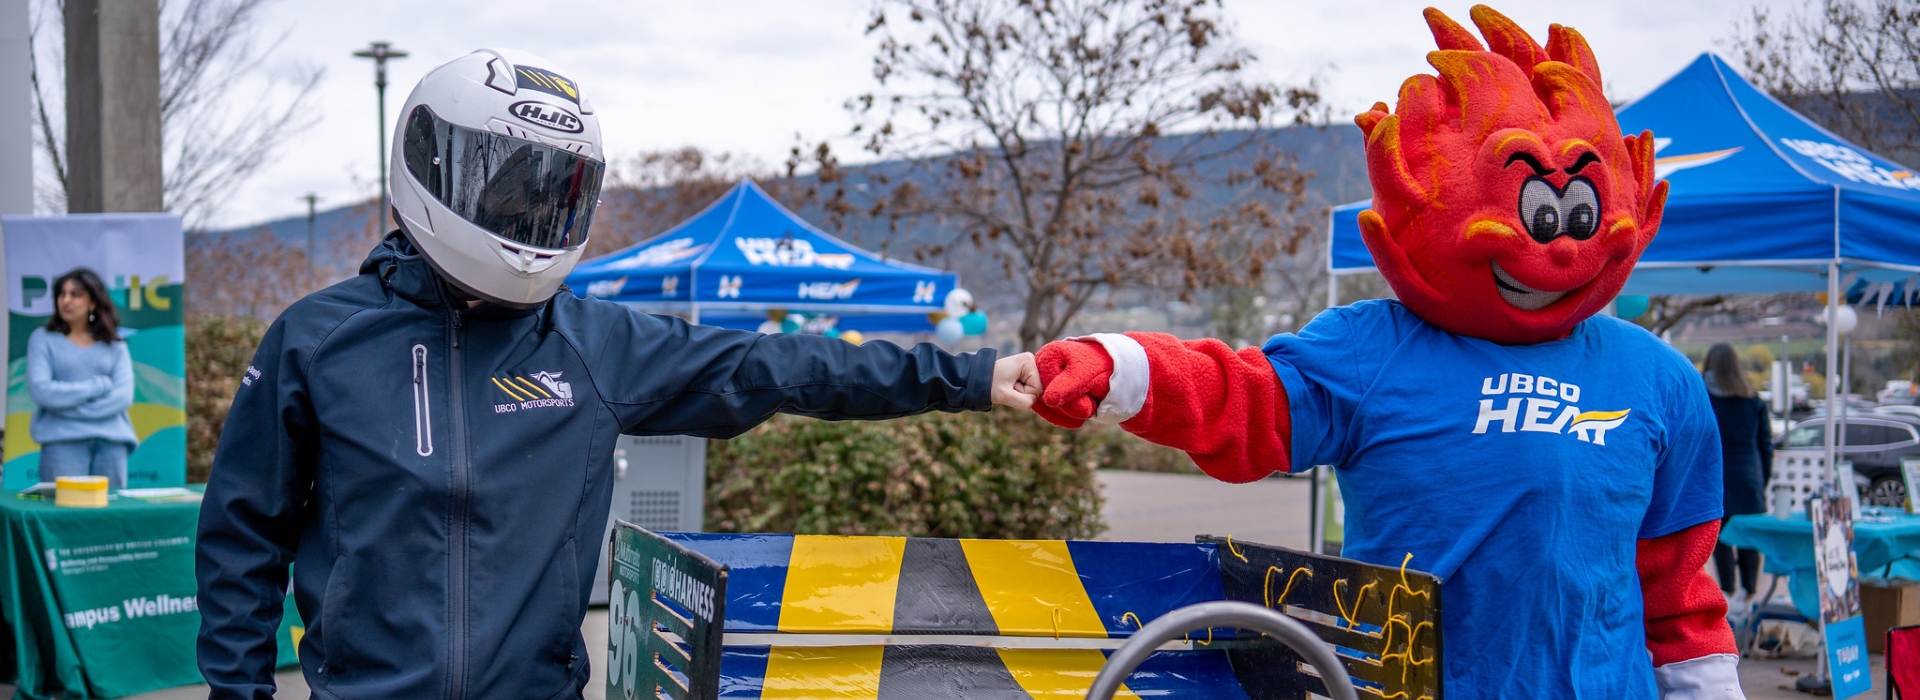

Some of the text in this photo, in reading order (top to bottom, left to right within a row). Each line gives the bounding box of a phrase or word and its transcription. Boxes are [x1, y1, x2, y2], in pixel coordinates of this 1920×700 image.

[518, 104, 577, 129] HJC
[798, 278, 860, 299] HEAT
[1481, 373, 1581, 403] UBCO
[494, 398, 574, 413] UBCO MOTORSPORTS
[1471, 397, 1631, 446] HEAT
[64, 605, 121, 630] ampus
[608, 579, 641, 700] 96
